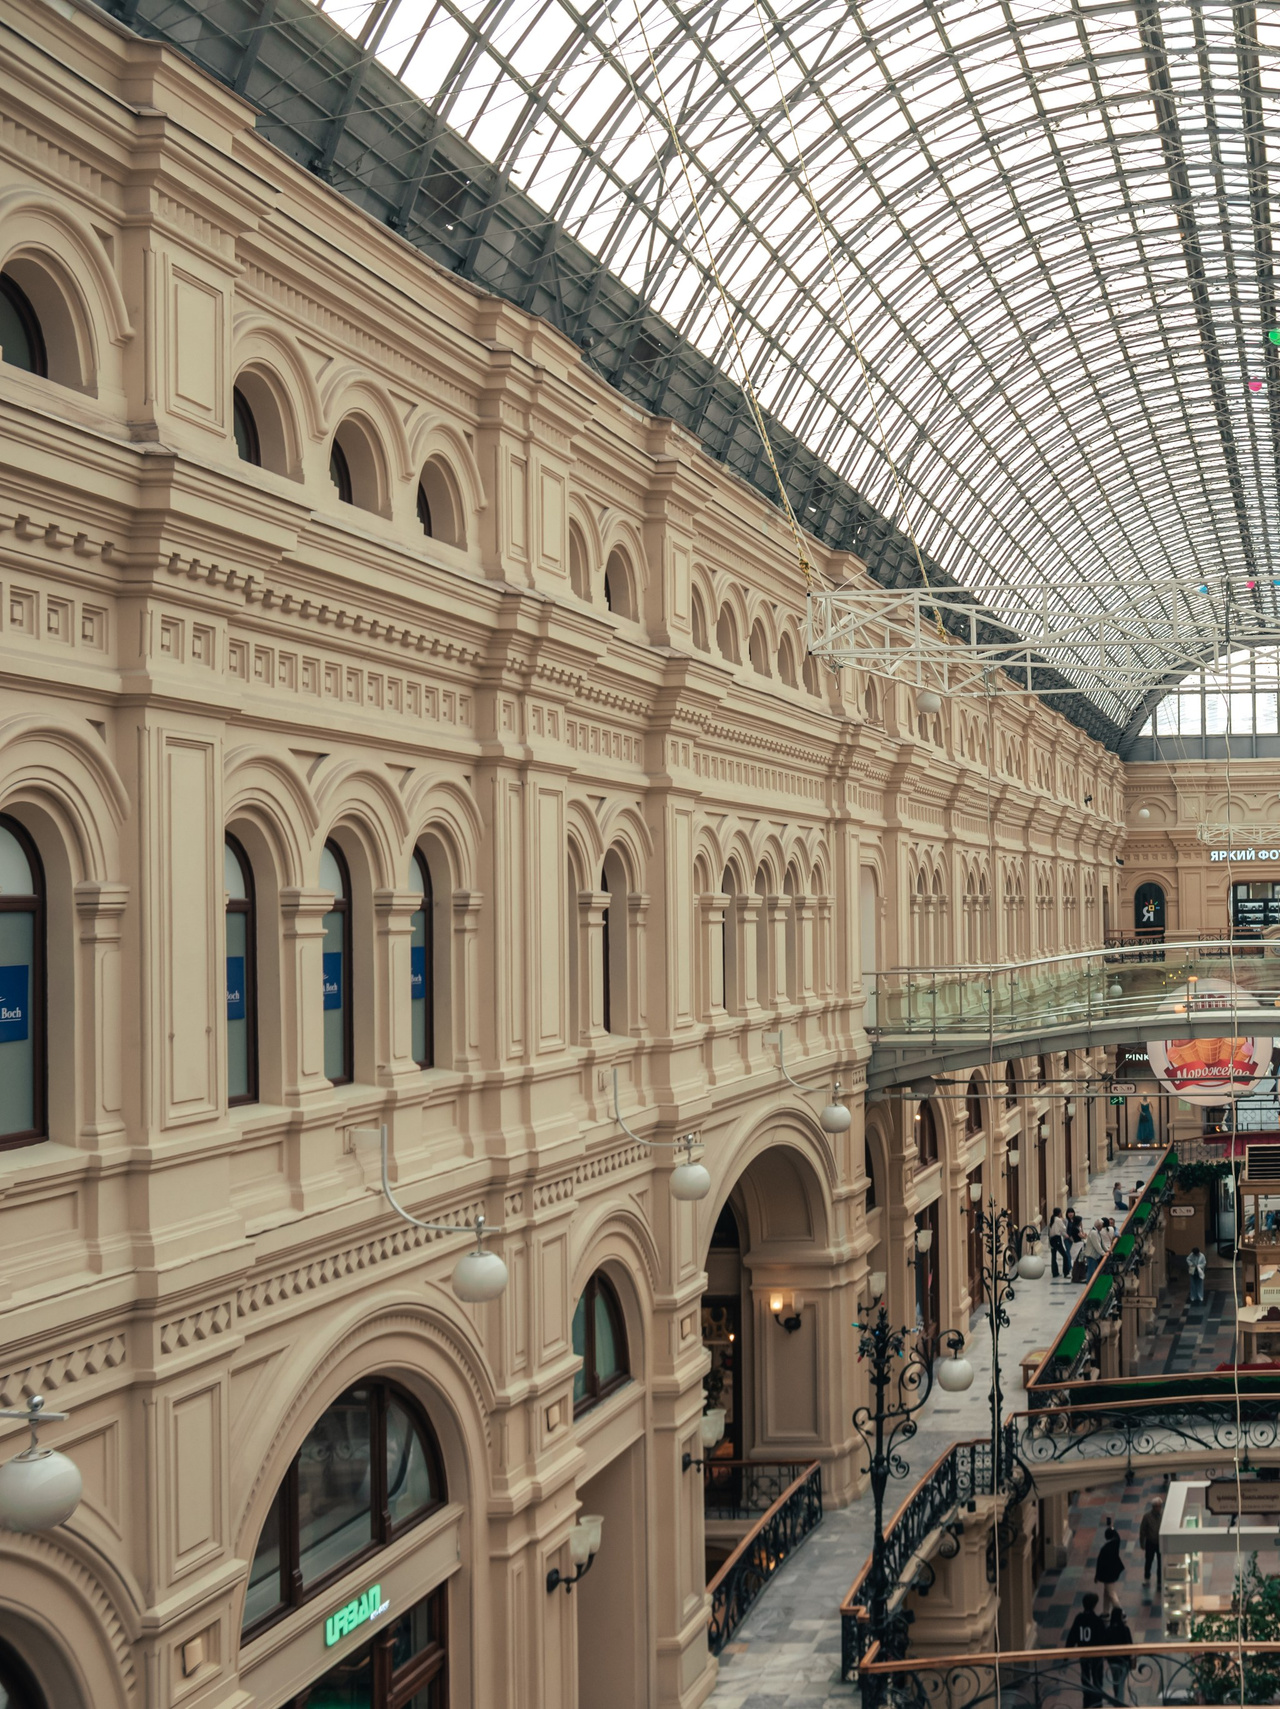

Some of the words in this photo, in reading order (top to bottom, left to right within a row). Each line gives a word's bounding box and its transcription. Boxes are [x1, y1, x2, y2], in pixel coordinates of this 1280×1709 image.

[1210, 848, 1255, 861] ЯРКИЙ
[1, 1007, 22, 1019] Boch
[326, 1584, 381, 1647] URBAN
[1079, 1626, 1092, 1642] 10
